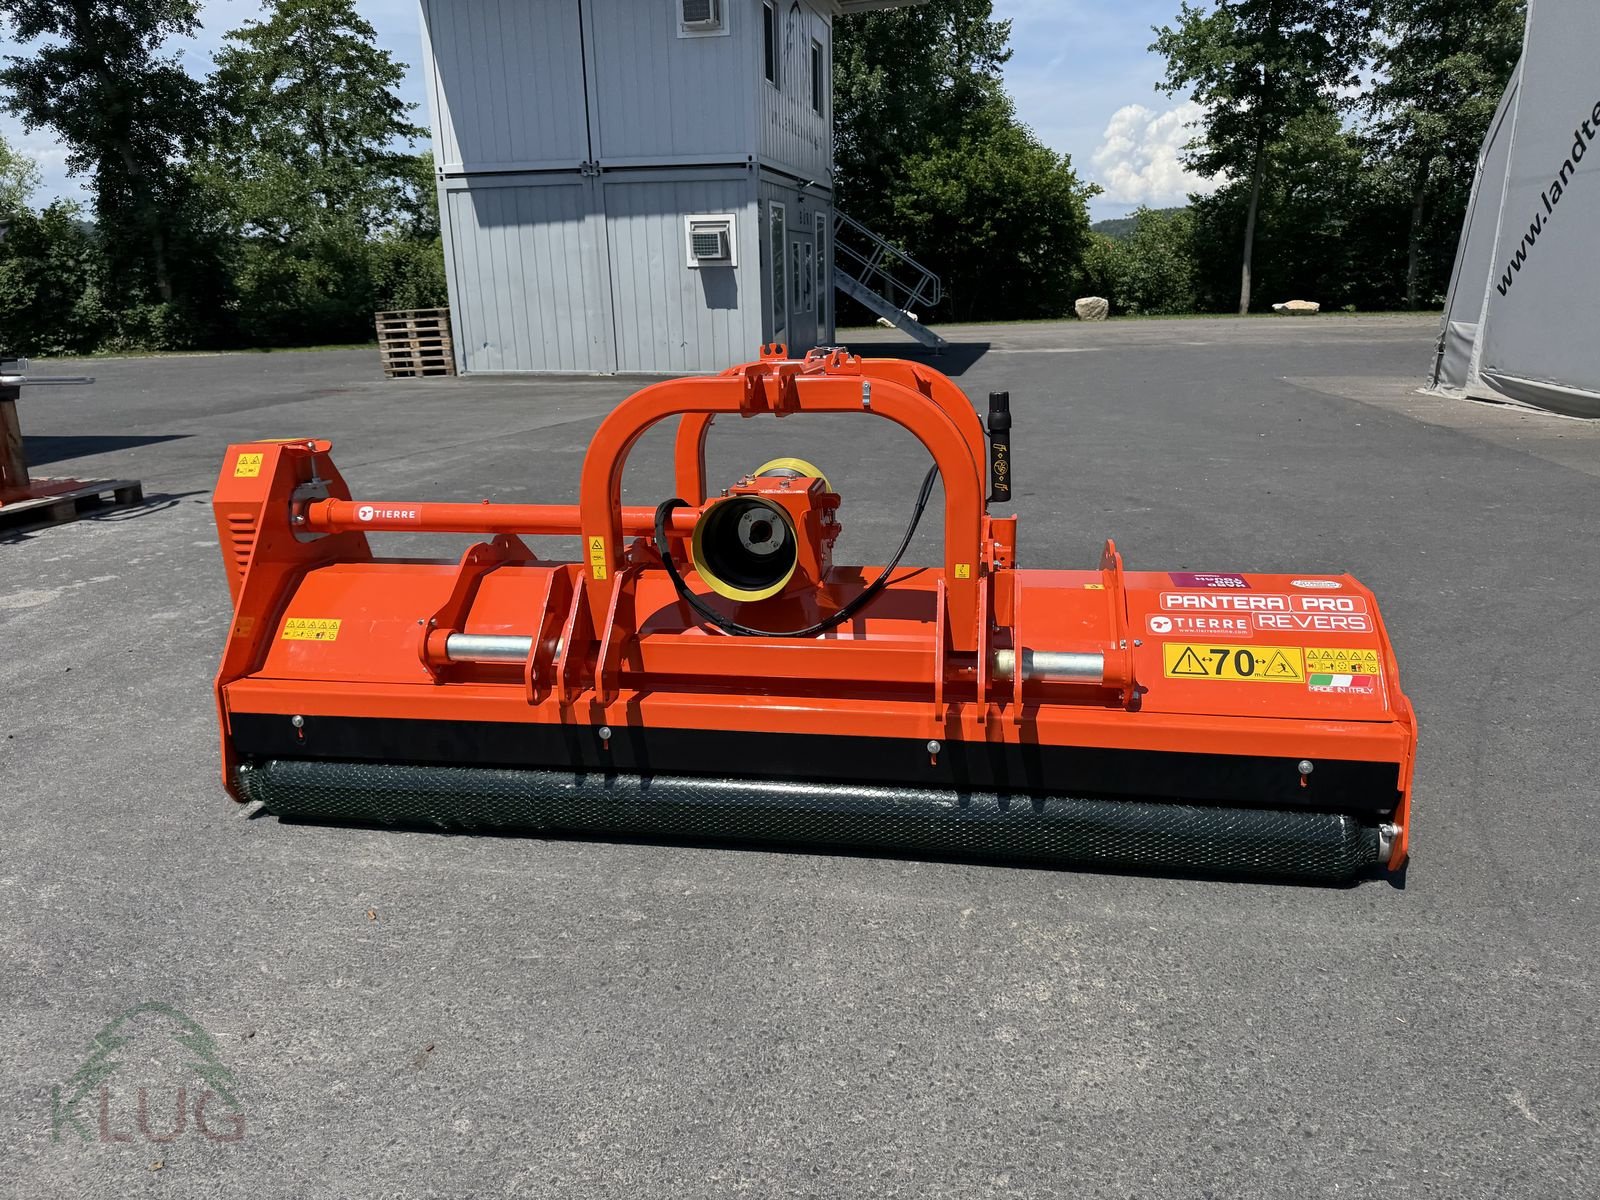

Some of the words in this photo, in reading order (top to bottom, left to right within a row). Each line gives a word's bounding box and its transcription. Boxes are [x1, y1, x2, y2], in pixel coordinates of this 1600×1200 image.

[374, 510, 416, 518] TIERRE
[1166, 595, 1285, 610] PANTERA
[1302, 597, 1354, 612] PRO
[1174, 618, 1247, 629] TIERRE
[1258, 614, 1366, 630] REVERS
[1209, 649, 1254, 676] 70
